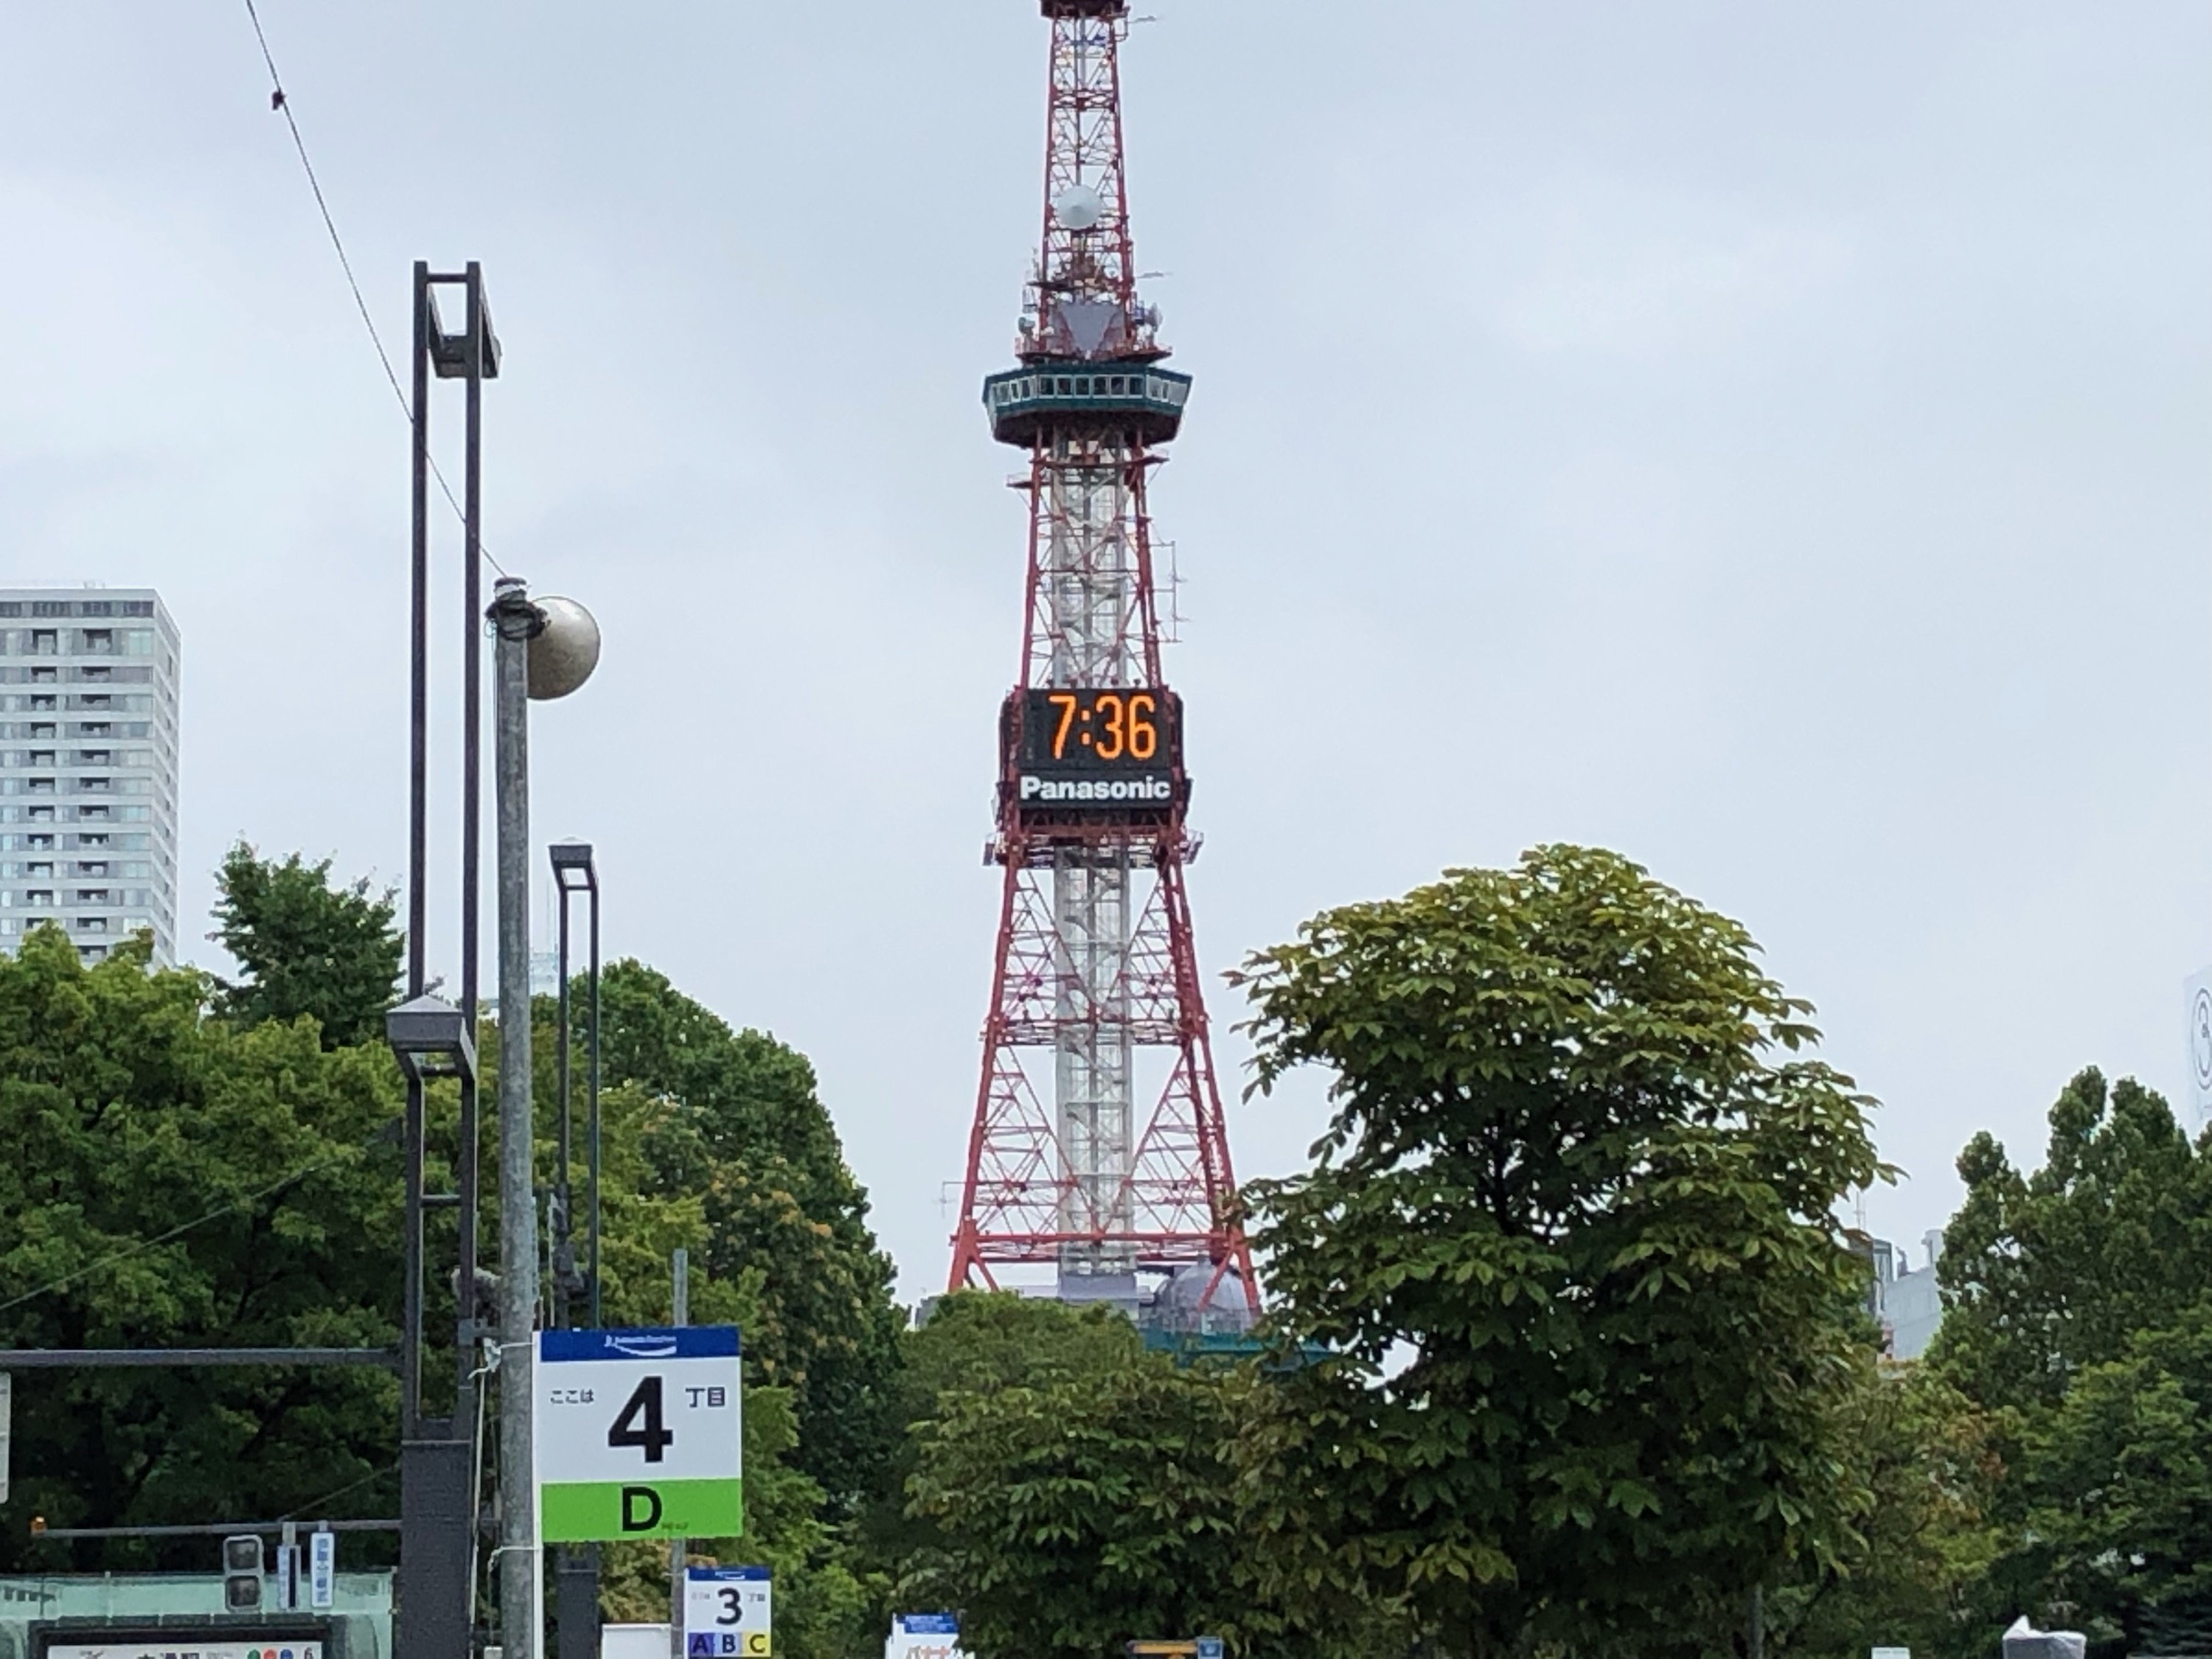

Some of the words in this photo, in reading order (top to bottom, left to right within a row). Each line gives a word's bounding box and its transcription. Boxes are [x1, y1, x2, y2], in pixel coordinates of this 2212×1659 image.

[1048, 695, 1156, 759] 7:36
[1020, 776, 1171, 800] Panasonic
[550, 1389, 594, 1404] ここは
[608, 1376, 673, 1463] 4
[685, 1386, 726, 1408] 丁目
[622, 1486, 662, 1531] D
[716, 1587, 743, 1626] 3
[693, 1634, 708, 1653] A
[723, 1634, 736, 1653] B
[749, 1634, 766, 1653] C
